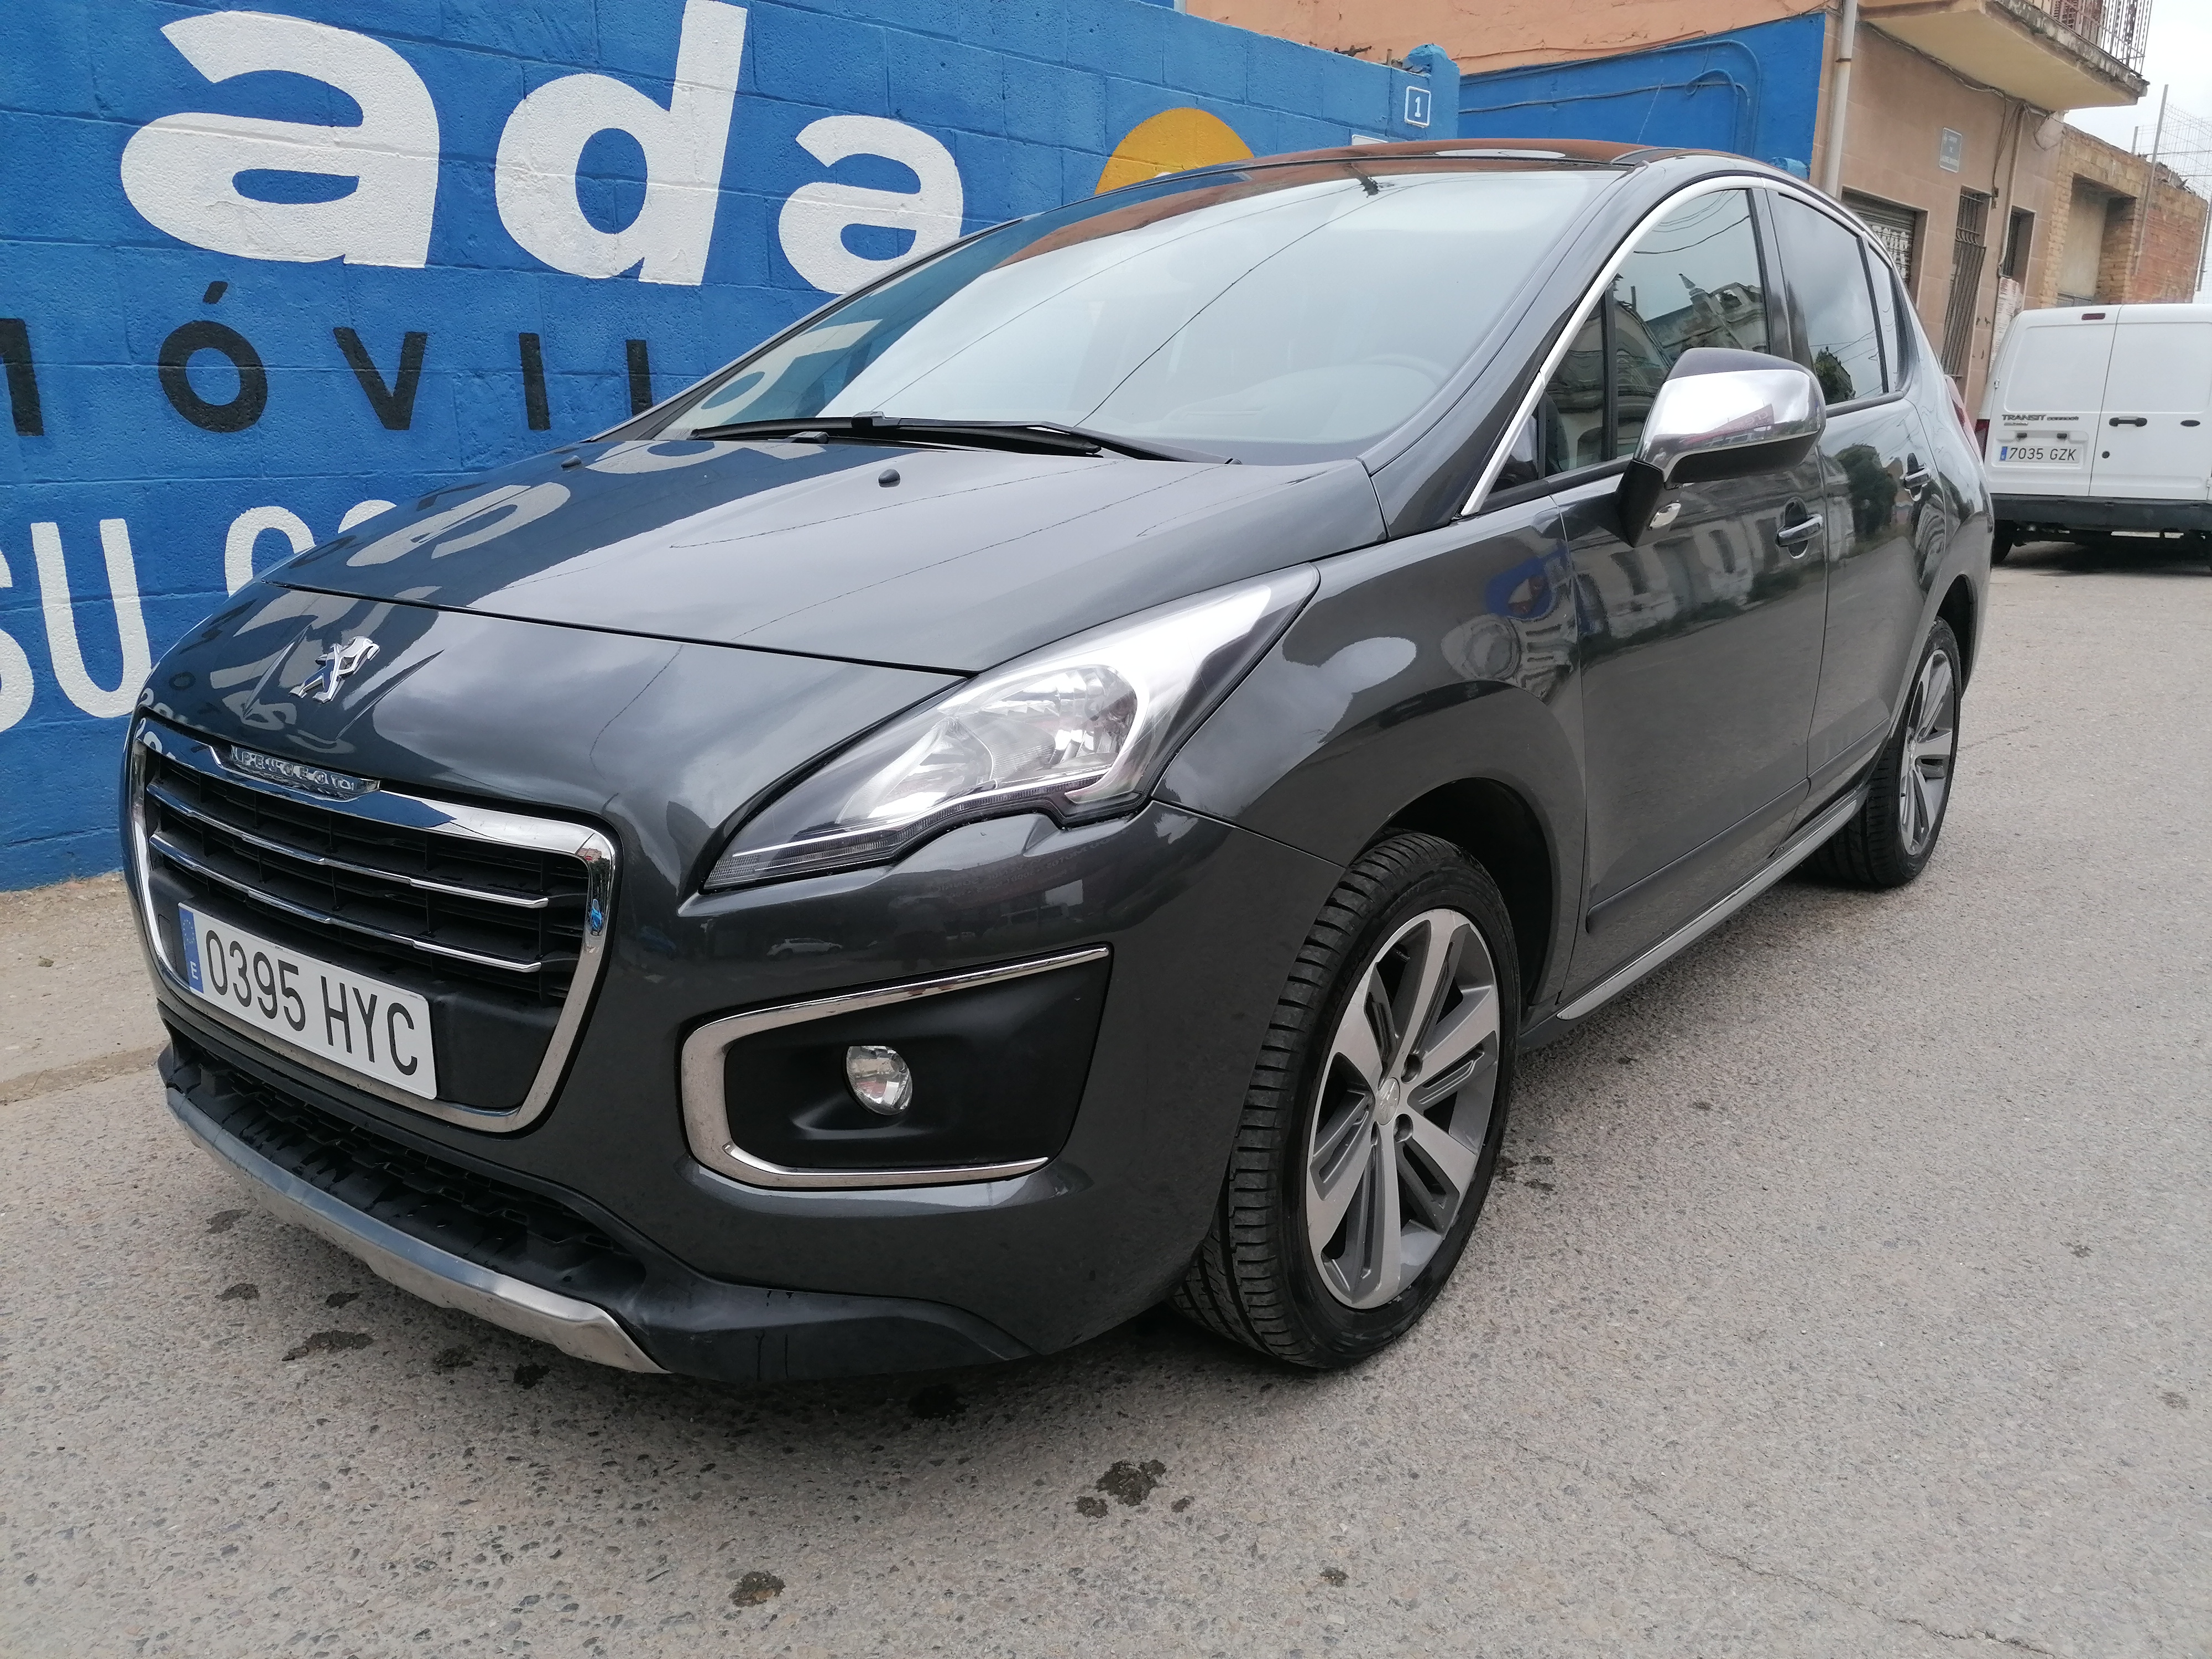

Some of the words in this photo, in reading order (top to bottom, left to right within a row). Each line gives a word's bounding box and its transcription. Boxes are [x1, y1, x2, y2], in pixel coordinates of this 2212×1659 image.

[1415, 96, 1421, 117] 1
[2009, 447, 2043, 460] 7035
[2050, 448, 2077, 461] GZK
[190, 961, 198, 980] E
[205, 930, 306, 1032] 0395
[321, 975, 418, 1076] HYC
